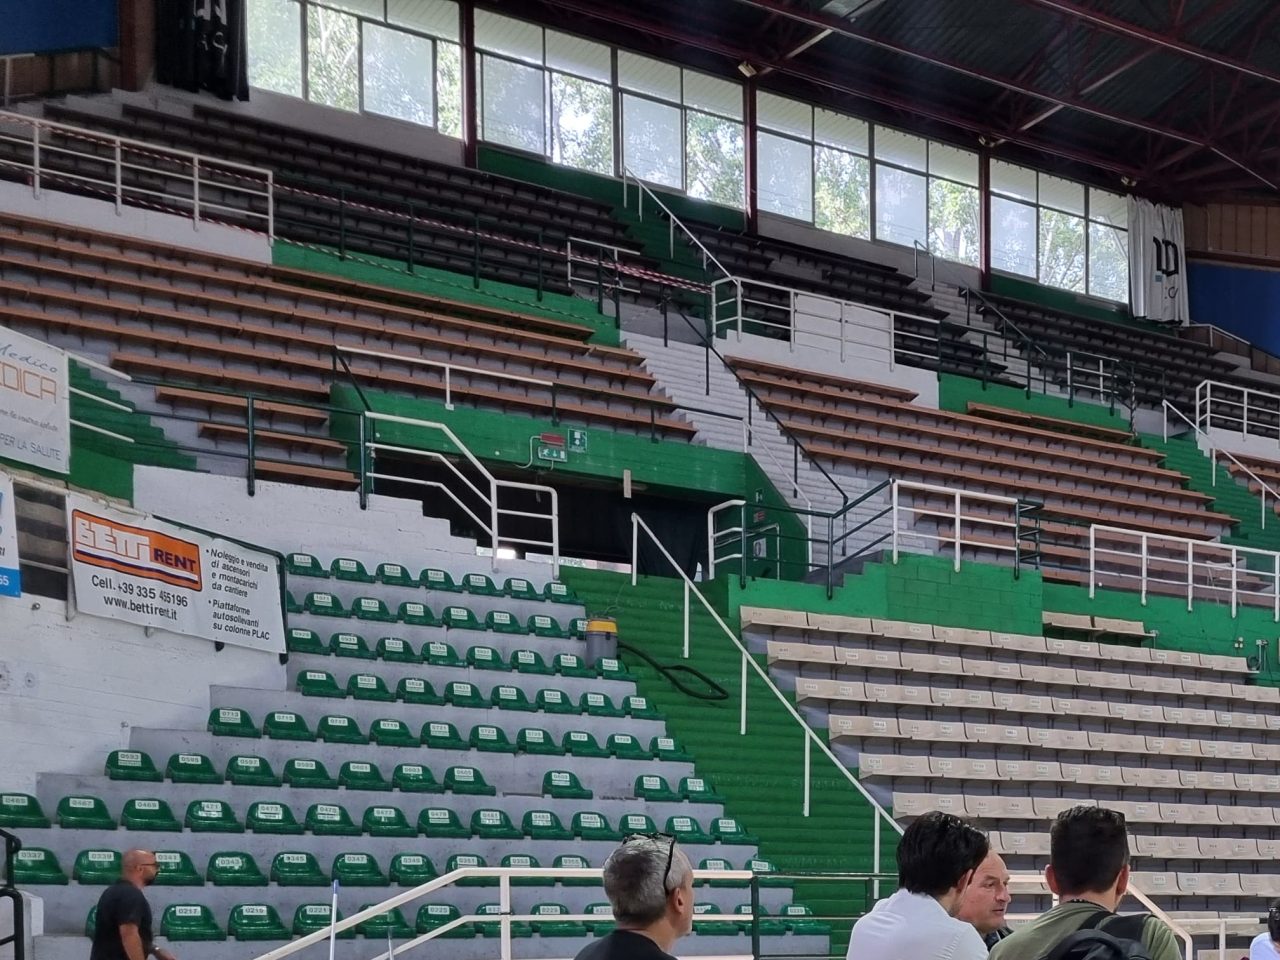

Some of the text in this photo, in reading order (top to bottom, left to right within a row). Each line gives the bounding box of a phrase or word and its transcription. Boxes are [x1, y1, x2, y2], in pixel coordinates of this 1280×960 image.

[0, 361, 57, 404] DICA
[153, 547, 196, 572] RENT
[211, 548, 240, 565] Noleggio
[246, 559, 269, 573] vendita
[221, 563, 250, 577] ascensori
[91, 574, 116, 591] Cell.
[117, 584, 134, 598] +39
[136, 586, 156, 600] 335
[211, 582, 222, 591] da
[212, 599, 251, 616] Piattaforme
[212, 622, 270, 641] su colonne PLAC
